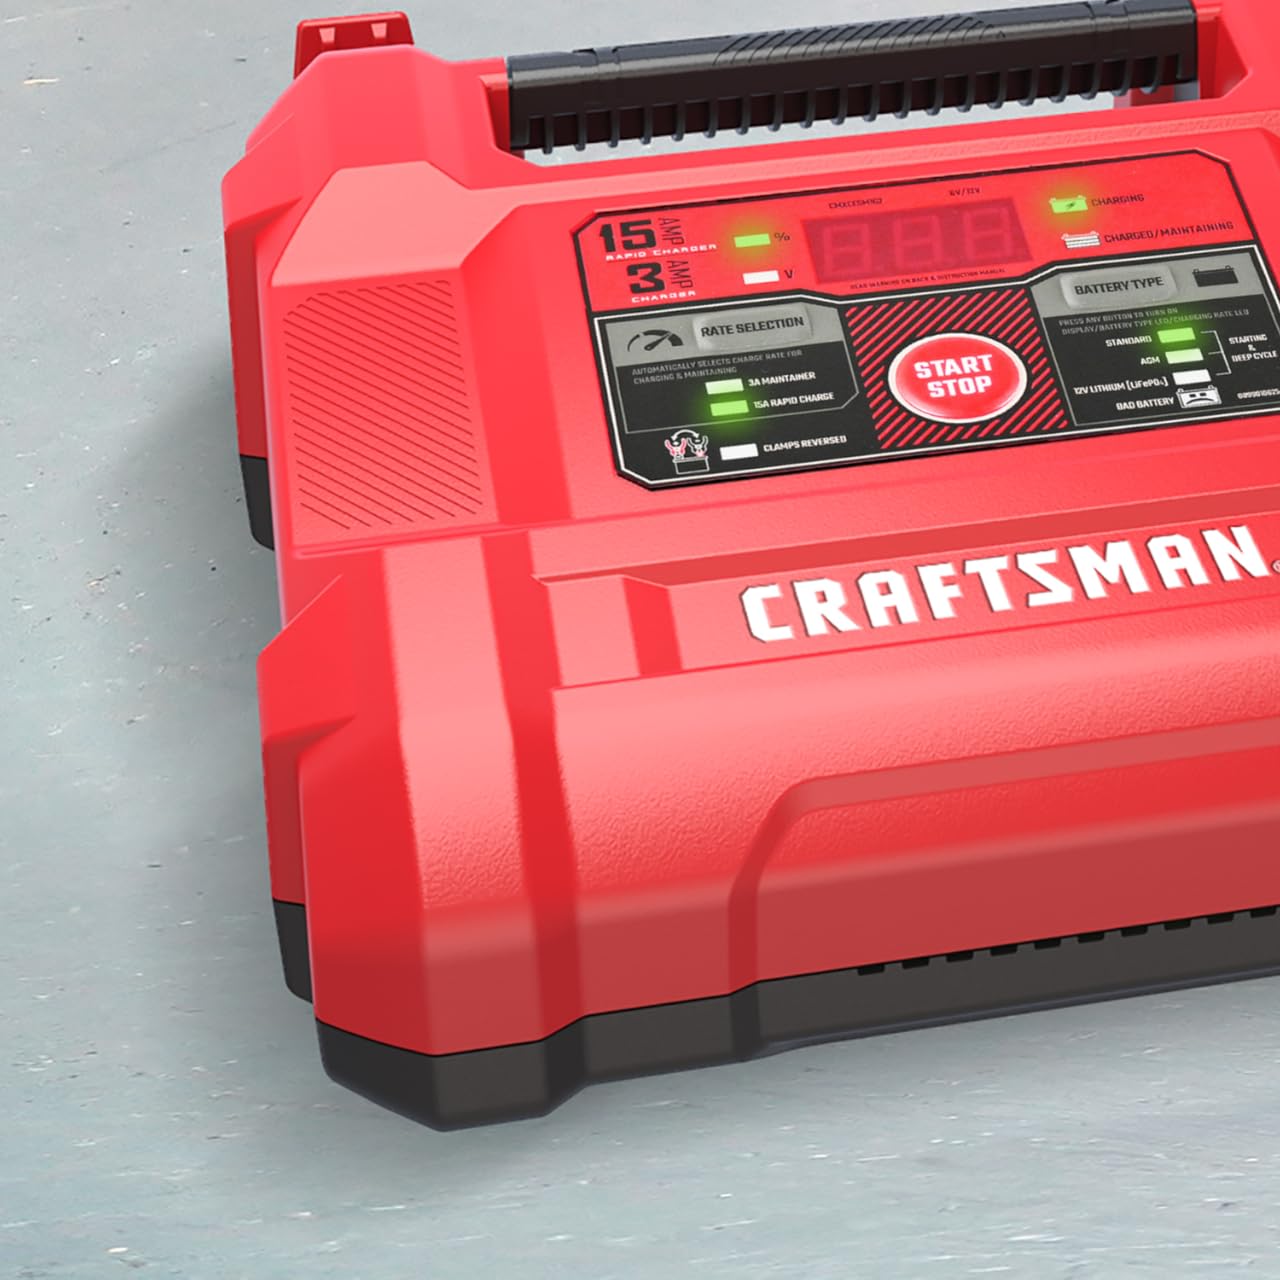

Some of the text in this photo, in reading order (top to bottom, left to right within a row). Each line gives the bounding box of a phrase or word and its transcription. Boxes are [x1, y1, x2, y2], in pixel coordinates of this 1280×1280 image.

[1092, 194, 1145, 207] CHARGING
[599, 219, 656, 253] 15
[658, 217, 685, 245] AMP
[774, 232, 790, 241] %
[605, 244, 717, 261] RAPID CHARGER
[626, 262, 665, 294] 3
[667, 260, 693, 289] AMP
[784, 270, 793, 279] V
[1074, 276, 1164, 296] BATTERY TYPE
[631, 290, 696, 303] CHARGER
[1058, 318, 1084, 326] PRESS
[1102, 312, 1133, 321] BUTTON
[1145, 309, 1166, 317] TURN
[701, 316, 804, 337] RATE SELECTION
[1105, 335, 1152, 347] STANDARD
[1228, 333, 1267, 345] STARTING
[632, 349, 802, 376] AUTOMATICALLY SELECTS CHARGE RATE FOR
[1140, 356, 1160, 366] AGM
[1232, 350, 1278, 363] DEEP CYCLE
[914, 354, 992, 379] START
[633, 374, 674, 385] CHARGING
[684, 366, 737, 378] MAINTAINING
[748, 371, 816, 387] 3A MAINTAINER
[927, 375, 992, 398] STOP
[1073, 386, 1089, 395] 12V
[1089, 382, 1126, 394] LITHIUM
[753, 392, 835, 409] 15A RAPID CHARGE
[1116, 396, 1174, 411] BAD BATTERY
[763, 435, 847, 453] CLAMPS REVERSED
[740, 524, 1270, 643] CRAFTSMAN
